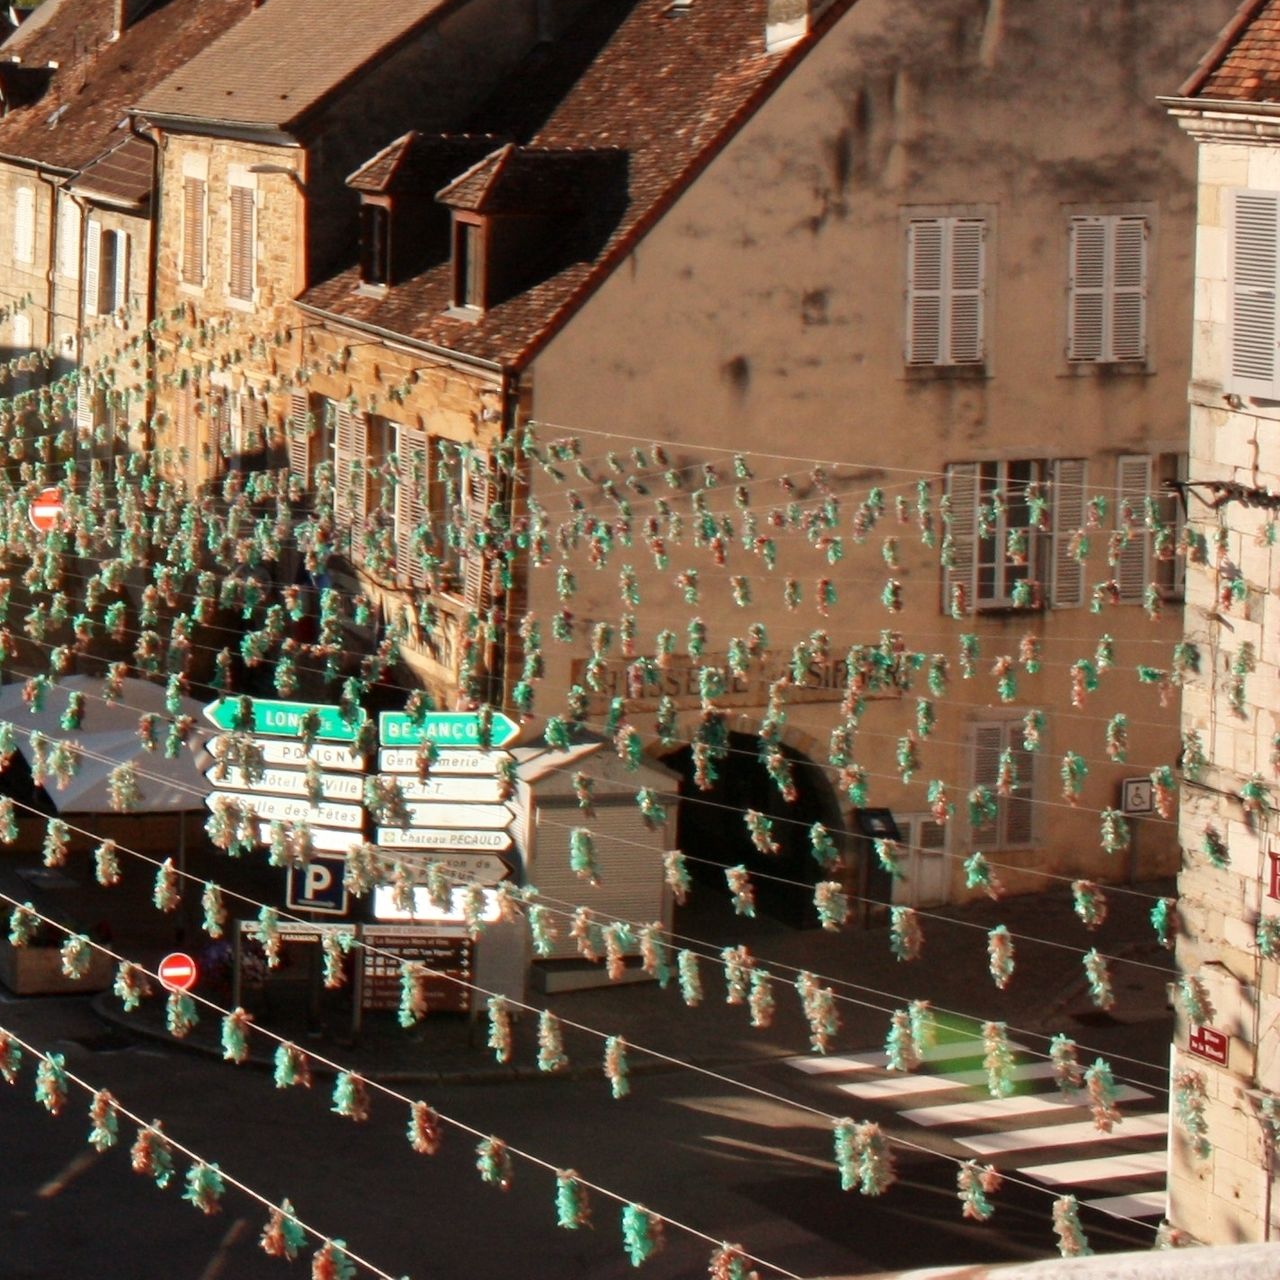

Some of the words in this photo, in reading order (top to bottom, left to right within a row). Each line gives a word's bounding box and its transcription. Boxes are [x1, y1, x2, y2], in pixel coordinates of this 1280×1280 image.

[265, 710, 308, 728] LON
[388, 721, 490, 739] BESANÇO
[283, 747, 357, 765] POIGNY
[386, 753, 479, 767] Genmerie
[284, 804, 309, 818] des
[305, 864, 332, 899] P
